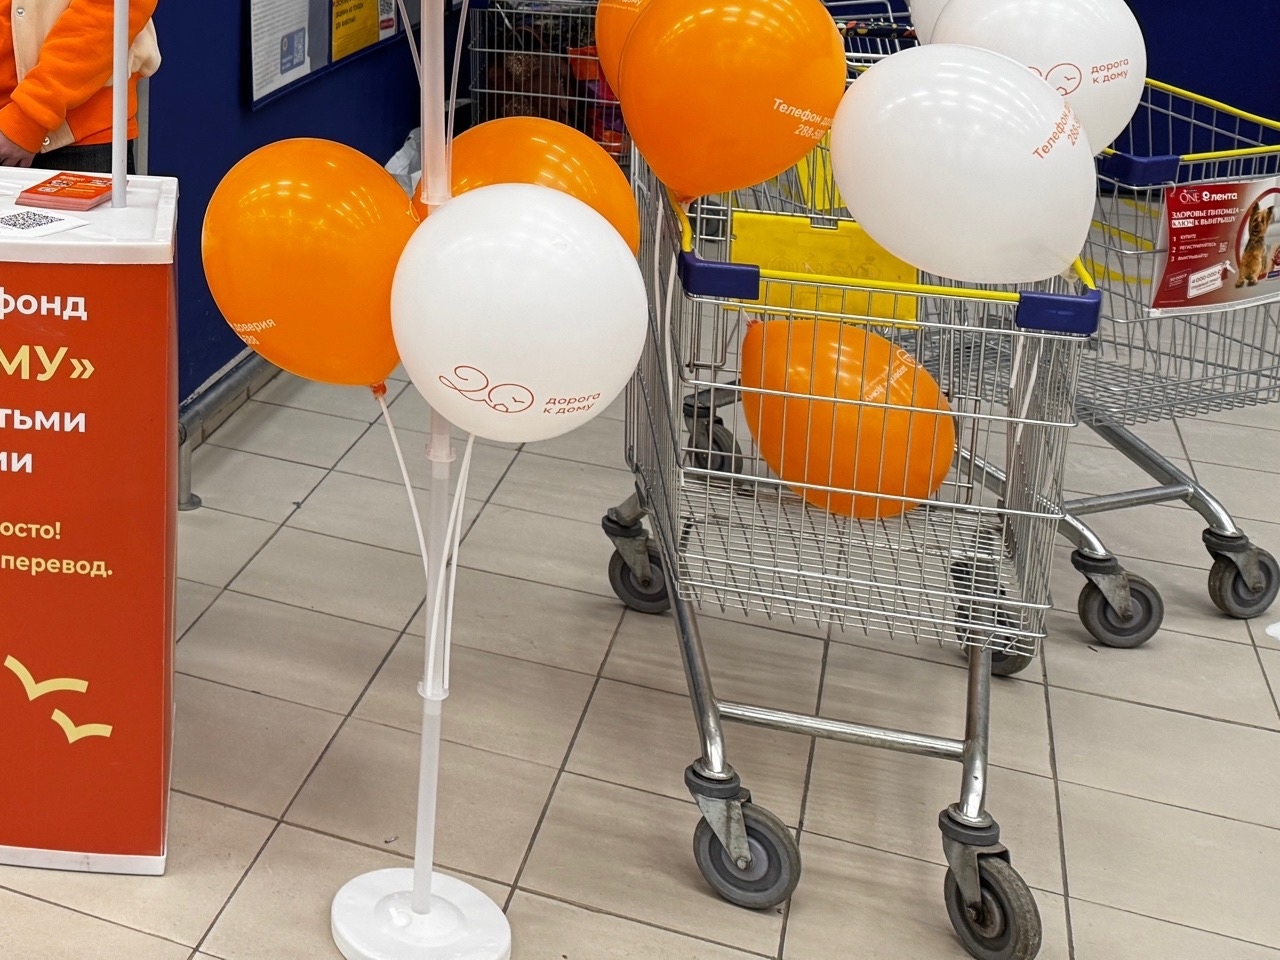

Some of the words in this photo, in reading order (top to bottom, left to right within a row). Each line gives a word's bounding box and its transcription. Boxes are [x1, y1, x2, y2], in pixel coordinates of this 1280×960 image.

[1091, 58, 1129, 74] дорога
[1102, 69, 1129, 84] дому
[773, 97, 821, 124] Телефон
[1033, 111, 1069, 159] Телефон
[1180, 192, 1200, 203] ONE
[1211, 192, 1238, 201] лента
[1172, 210, 1207, 219] ЗДОРОВЬЕ
[545, 393, 601, 406] дорога
[555, 403, 594, 415] дому
[0, 552, 113, 579] перевод.
